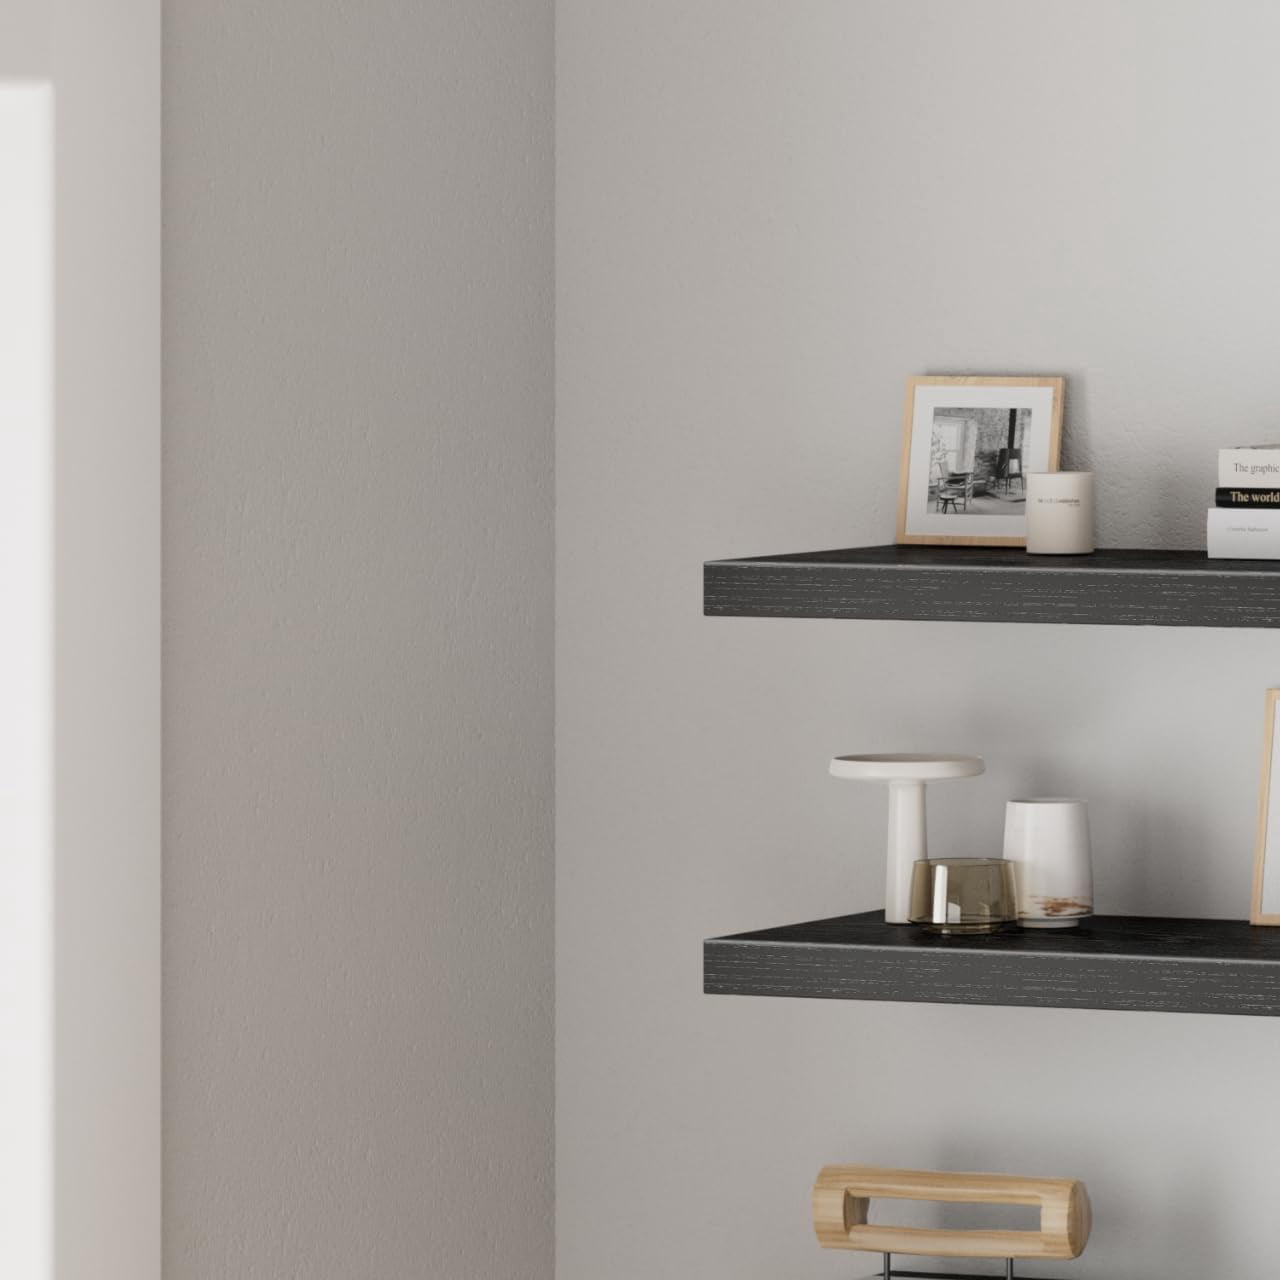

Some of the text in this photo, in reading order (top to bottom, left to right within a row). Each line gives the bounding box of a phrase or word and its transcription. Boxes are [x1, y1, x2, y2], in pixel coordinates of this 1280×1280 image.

[1233, 463, 1248, 473] The
[1250, 463, 1279, 475] graphic
[1230, 491, 1249, 503] The
[1251, 491, 1280, 503] world
